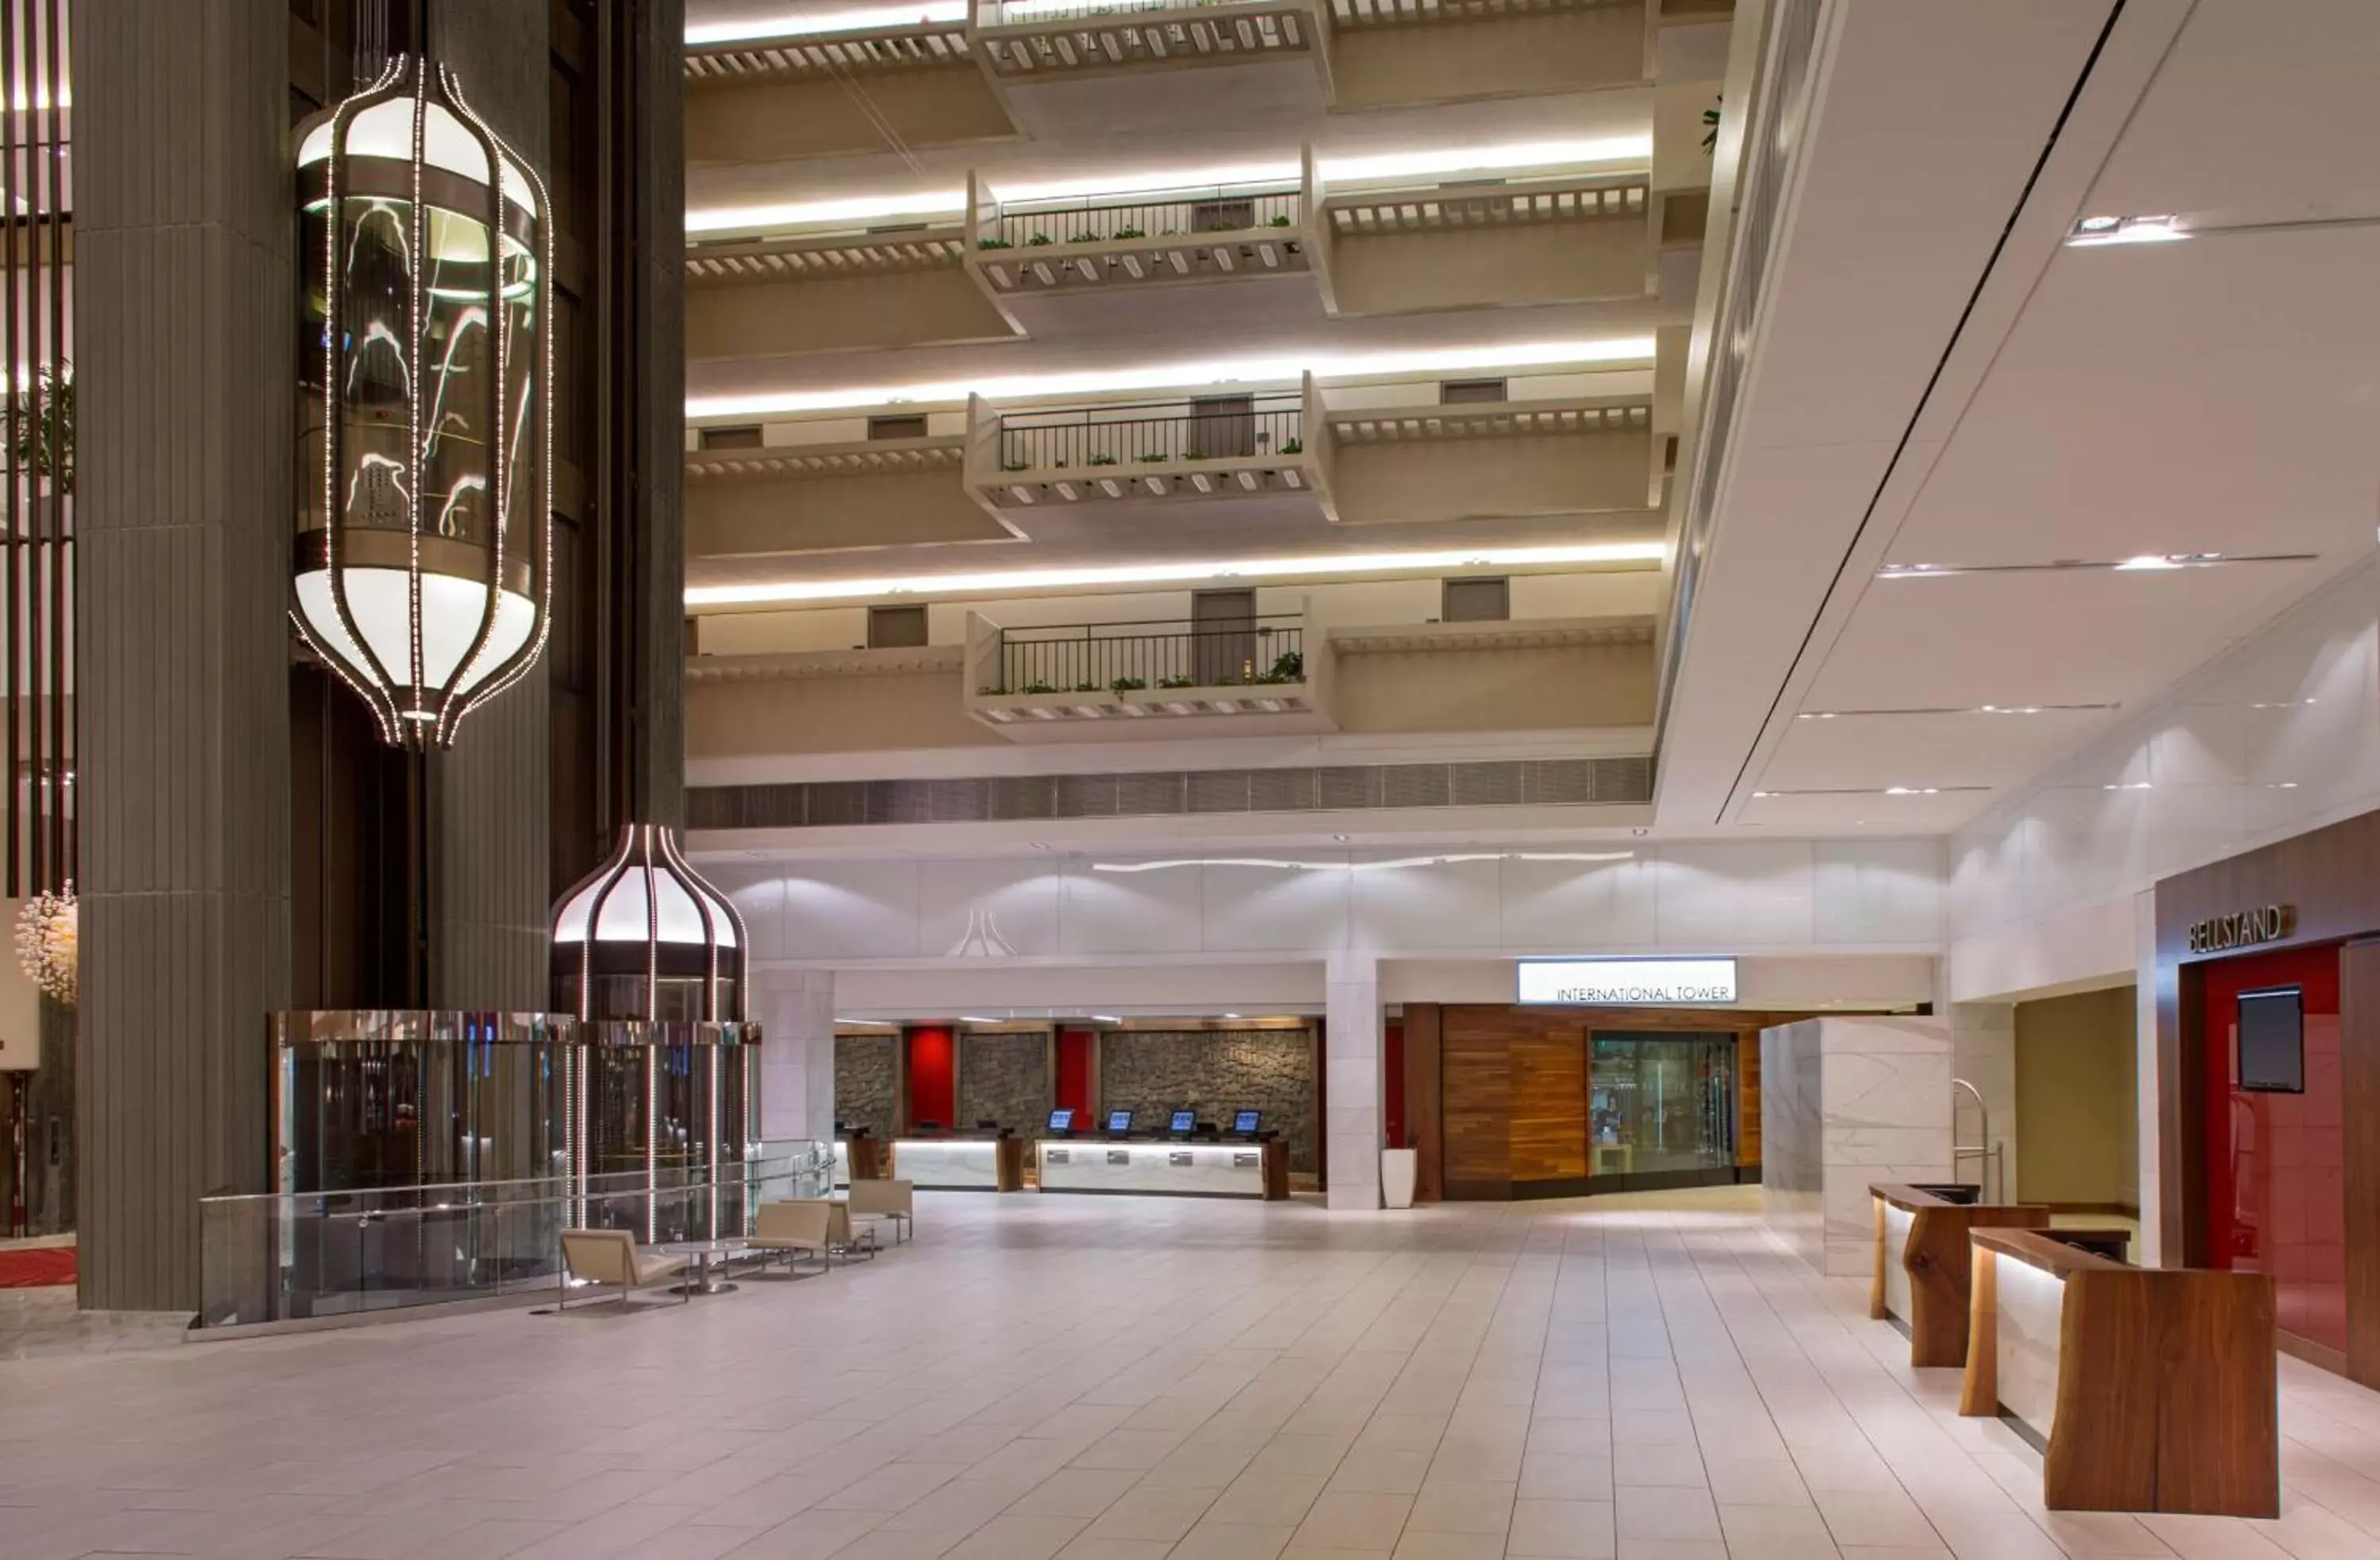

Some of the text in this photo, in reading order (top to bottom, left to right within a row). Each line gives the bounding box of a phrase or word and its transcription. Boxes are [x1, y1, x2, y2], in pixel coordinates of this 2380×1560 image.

[2188, 904, 2282, 953] BELLSTAND
[1557, 986, 1729, 1001] INTERNATIONAL TOWER
